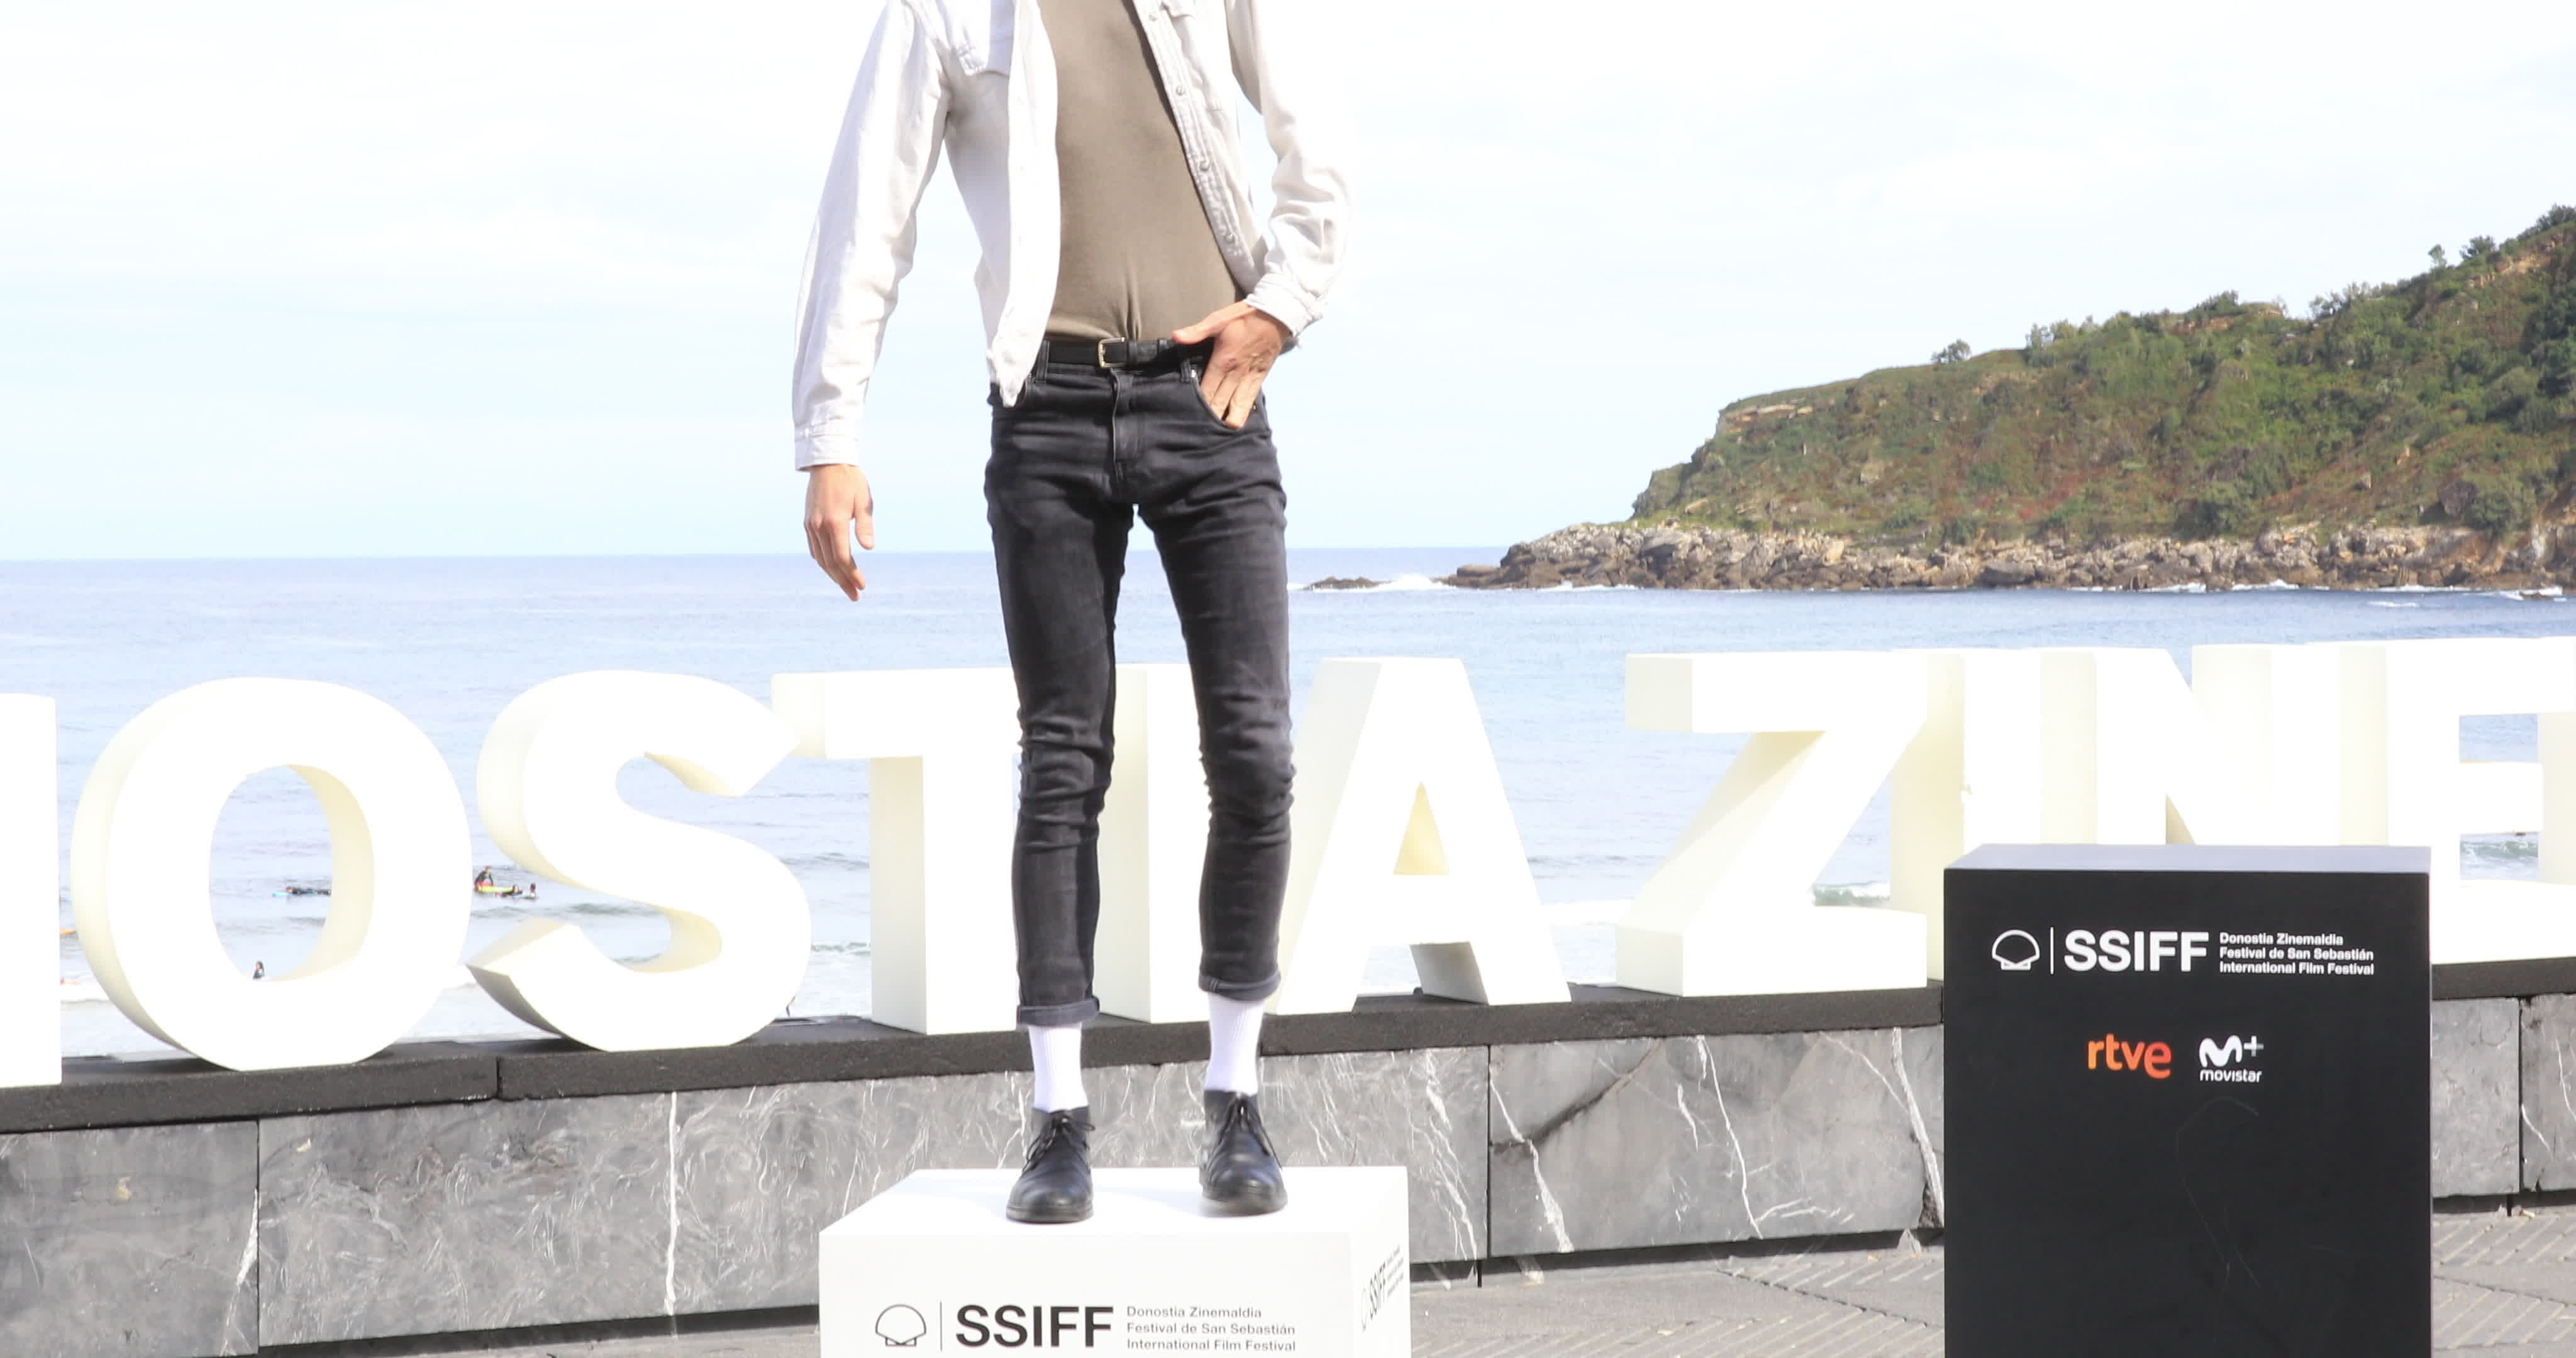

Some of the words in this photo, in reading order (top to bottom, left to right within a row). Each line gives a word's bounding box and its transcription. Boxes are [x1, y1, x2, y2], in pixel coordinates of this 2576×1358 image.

[0, 658, 1571, 1086] OSTIA
[1614, 636, 2576, 997] ZINE
[2219, 932, 2274, 944] Donostia
[2276, 932, 2344, 946] Zinemaldia
[2063, 929, 2210, 973] SSIFF
[2219, 946, 2266, 959] Festival
[2268, 947, 2285, 959] de
[2287, 947, 2311, 959] San
[2314, 947, 2375, 961] Sebastián
[2219, 961, 2296, 974] International
[2299, 962, 2324, 974] Film
[2327, 963, 2375, 975] Festival
[2087, 1033, 2173, 1079] rtve
[2199, 1068, 2262, 1083] movistar
[1126, 1305, 1185, 1318] Donostia
[1189, 1306, 1262, 1318] Zinemaldia
[955, 1304, 1114, 1347] SSIFF
[1126, 1322, 1177, 1333] Festival
[1181, 1323, 1197, 1333] de
[1202, 1323, 1226, 1334] San
[1230, 1323, 1296, 1335] Sebastián
[1126, 1339, 1210, 1350] International
[1214, 1339, 1241, 1350] Film
[1245, 1340, 1296, 1352] Festival
